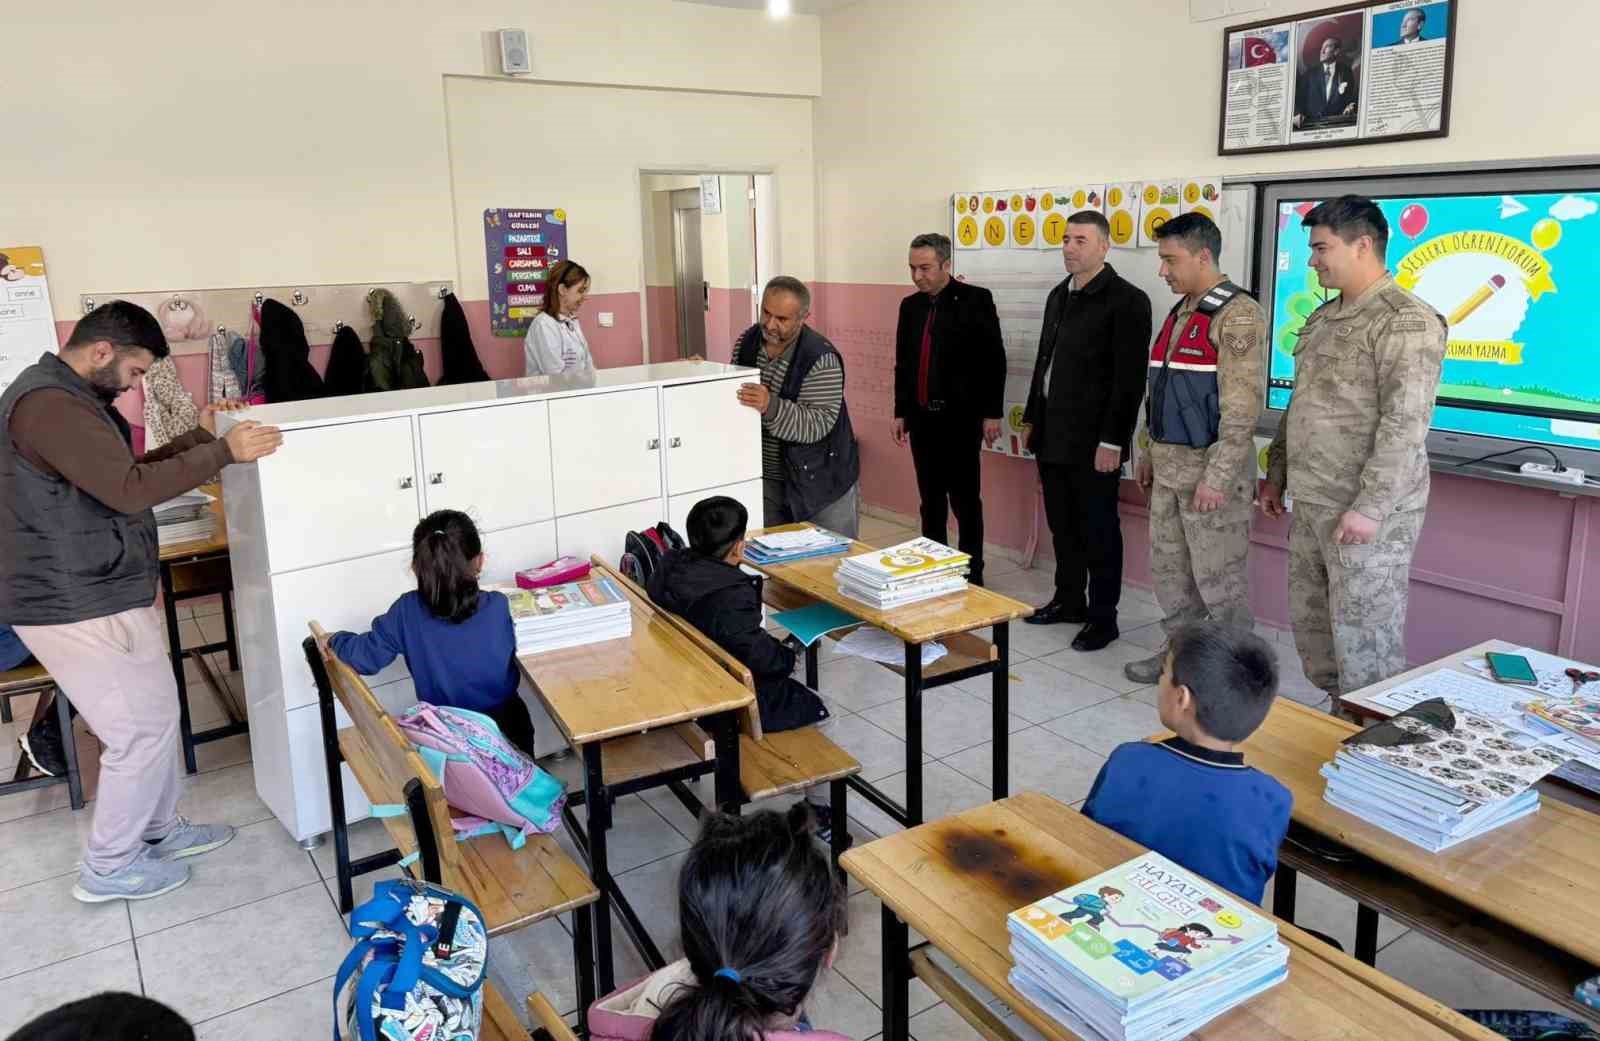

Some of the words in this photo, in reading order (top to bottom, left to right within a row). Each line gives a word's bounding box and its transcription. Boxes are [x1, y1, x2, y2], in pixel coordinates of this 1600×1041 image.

[962, 223, 973, 239] A
[989, 223, 1000, 239] N
[1019, 222, 1028, 238] E
[1049, 220, 1060, 242] T
[1116, 218, 1125, 236] L
[517, 284, 537, 292] CUMA
[1137, 861, 1203, 897] HAYAT
